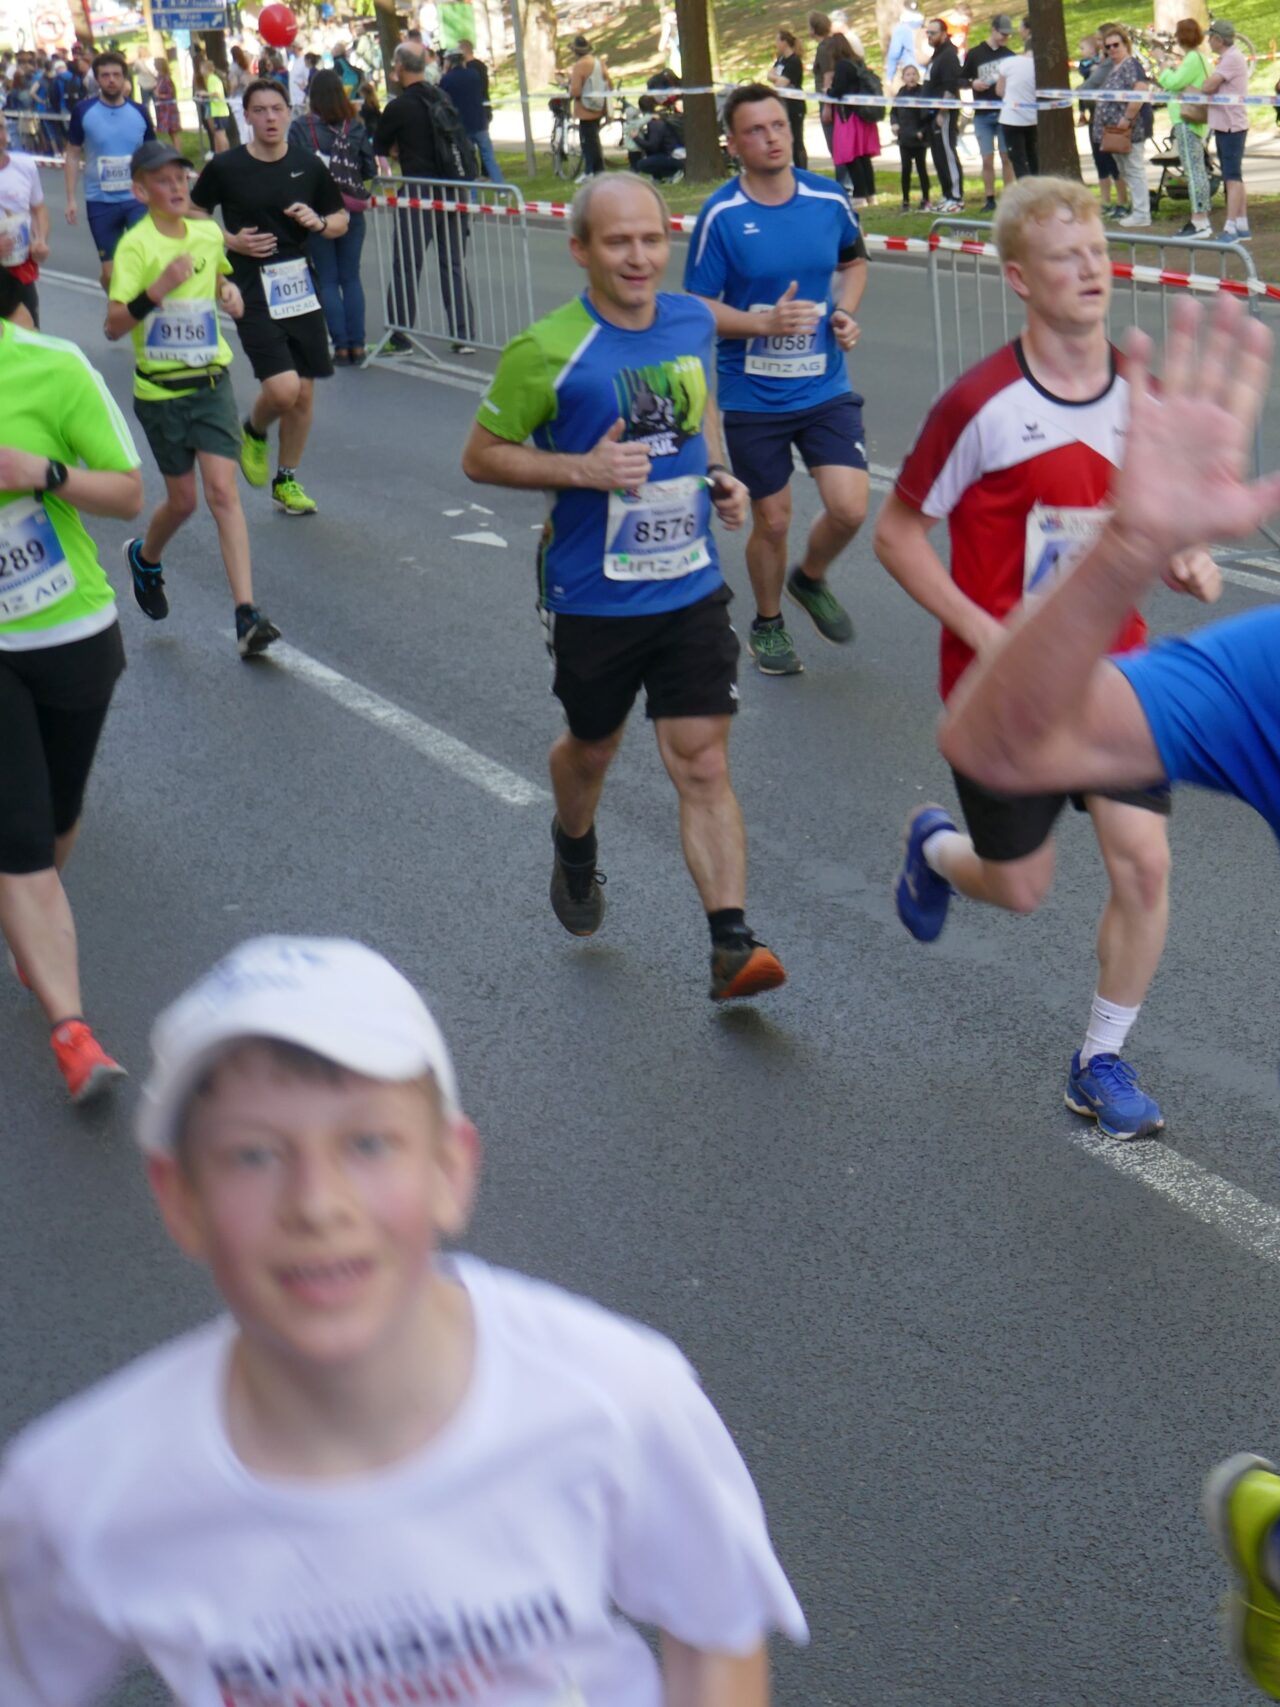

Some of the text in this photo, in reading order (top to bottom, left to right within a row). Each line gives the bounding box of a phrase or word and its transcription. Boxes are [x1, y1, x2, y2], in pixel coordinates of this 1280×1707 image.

[161, 323, 206, 341] 9156
[762, 333, 817, 351] 10587
[751, 360, 820, 373] LINZ AG
[633, 513, 696, 543] 8576
